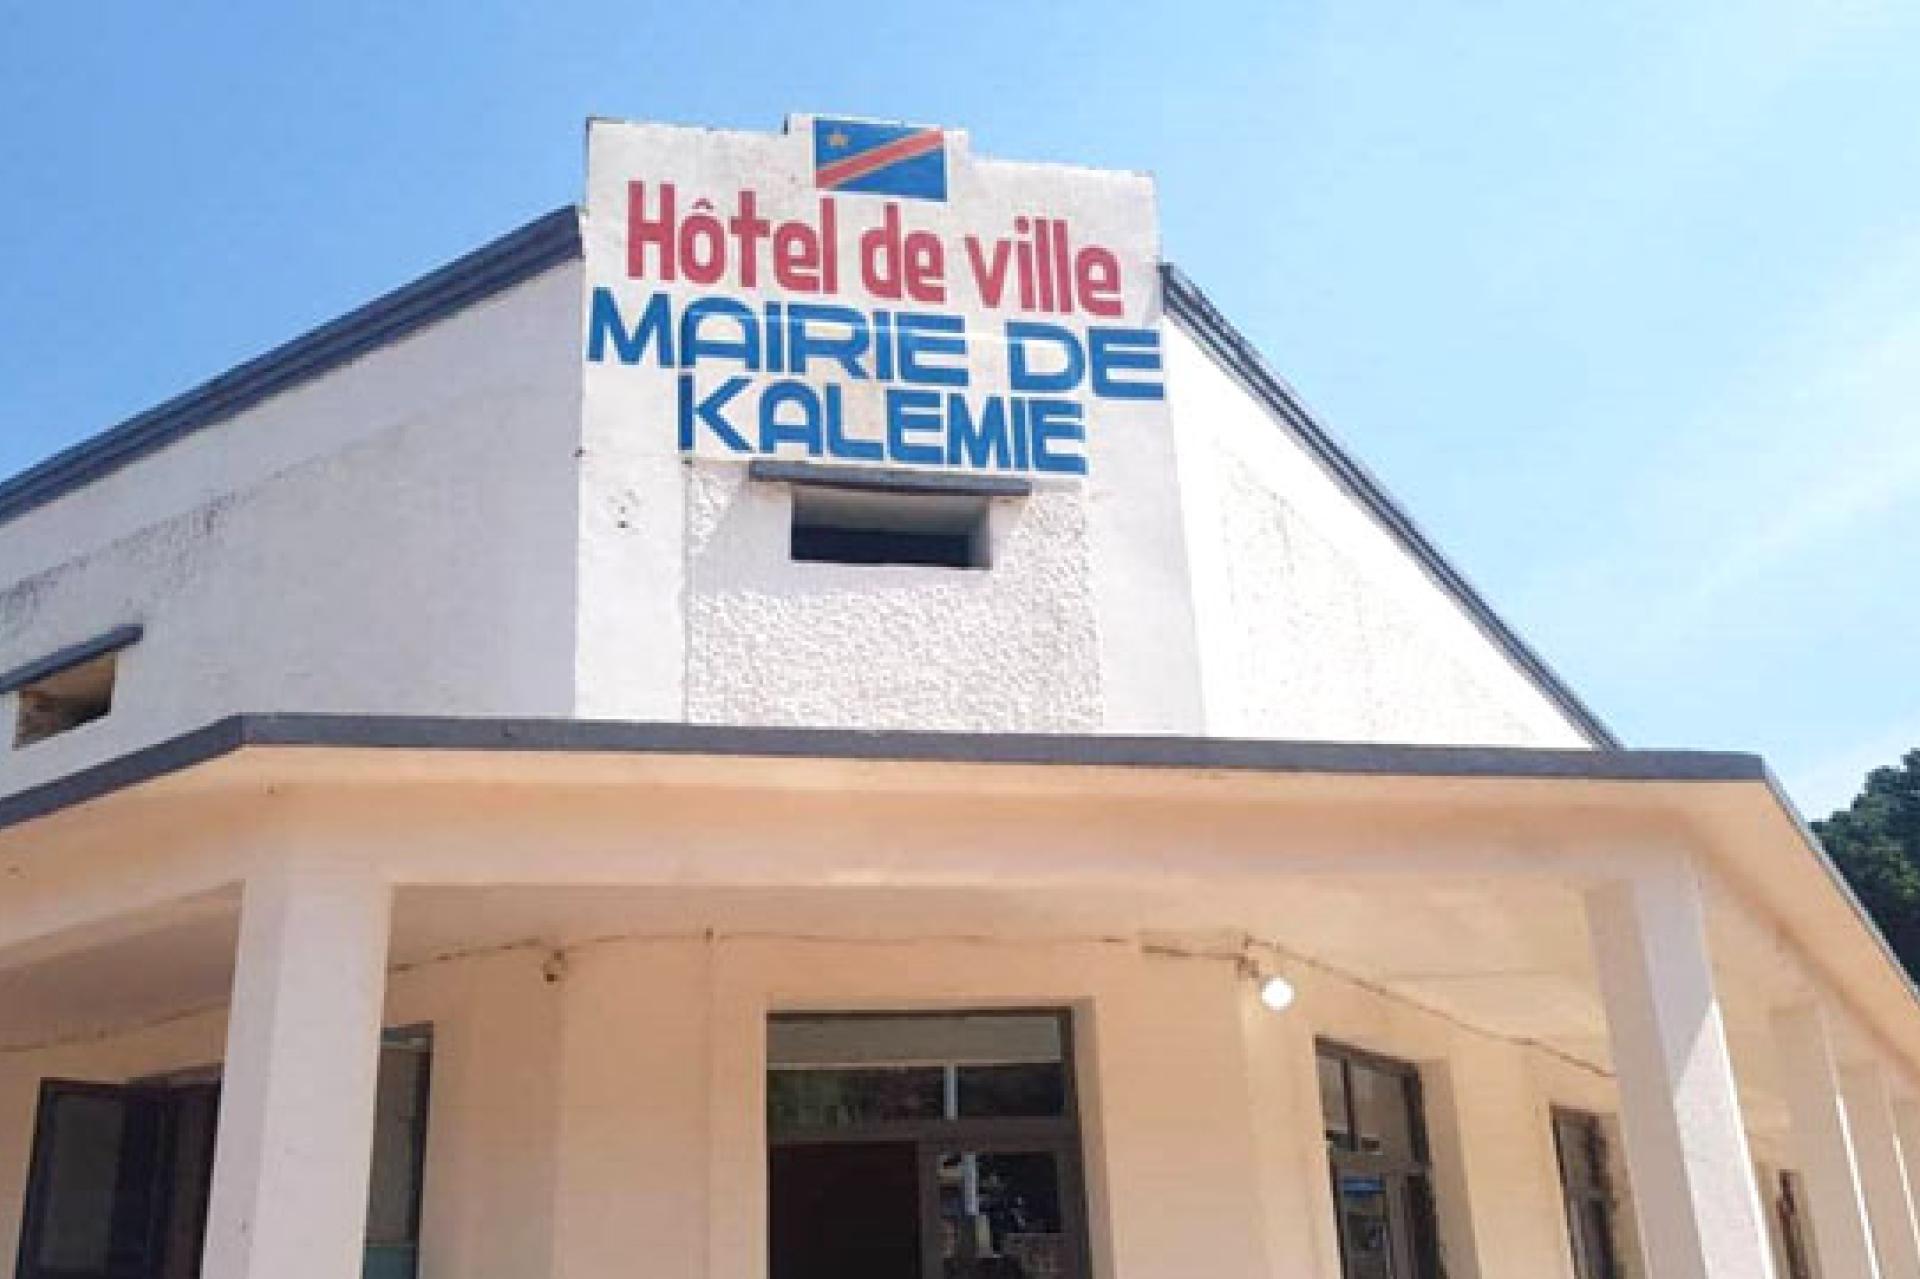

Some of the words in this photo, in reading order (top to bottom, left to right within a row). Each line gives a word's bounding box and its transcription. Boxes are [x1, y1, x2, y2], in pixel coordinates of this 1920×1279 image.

[626, 180, 838, 294] Hôtel
[861, 203, 946, 303] de
[964, 216, 1124, 316] ville
[586, 287, 969, 387] MAIRIE
[1006, 321, 1164, 400] DE
[677, 374, 1088, 475] KALEMIE
